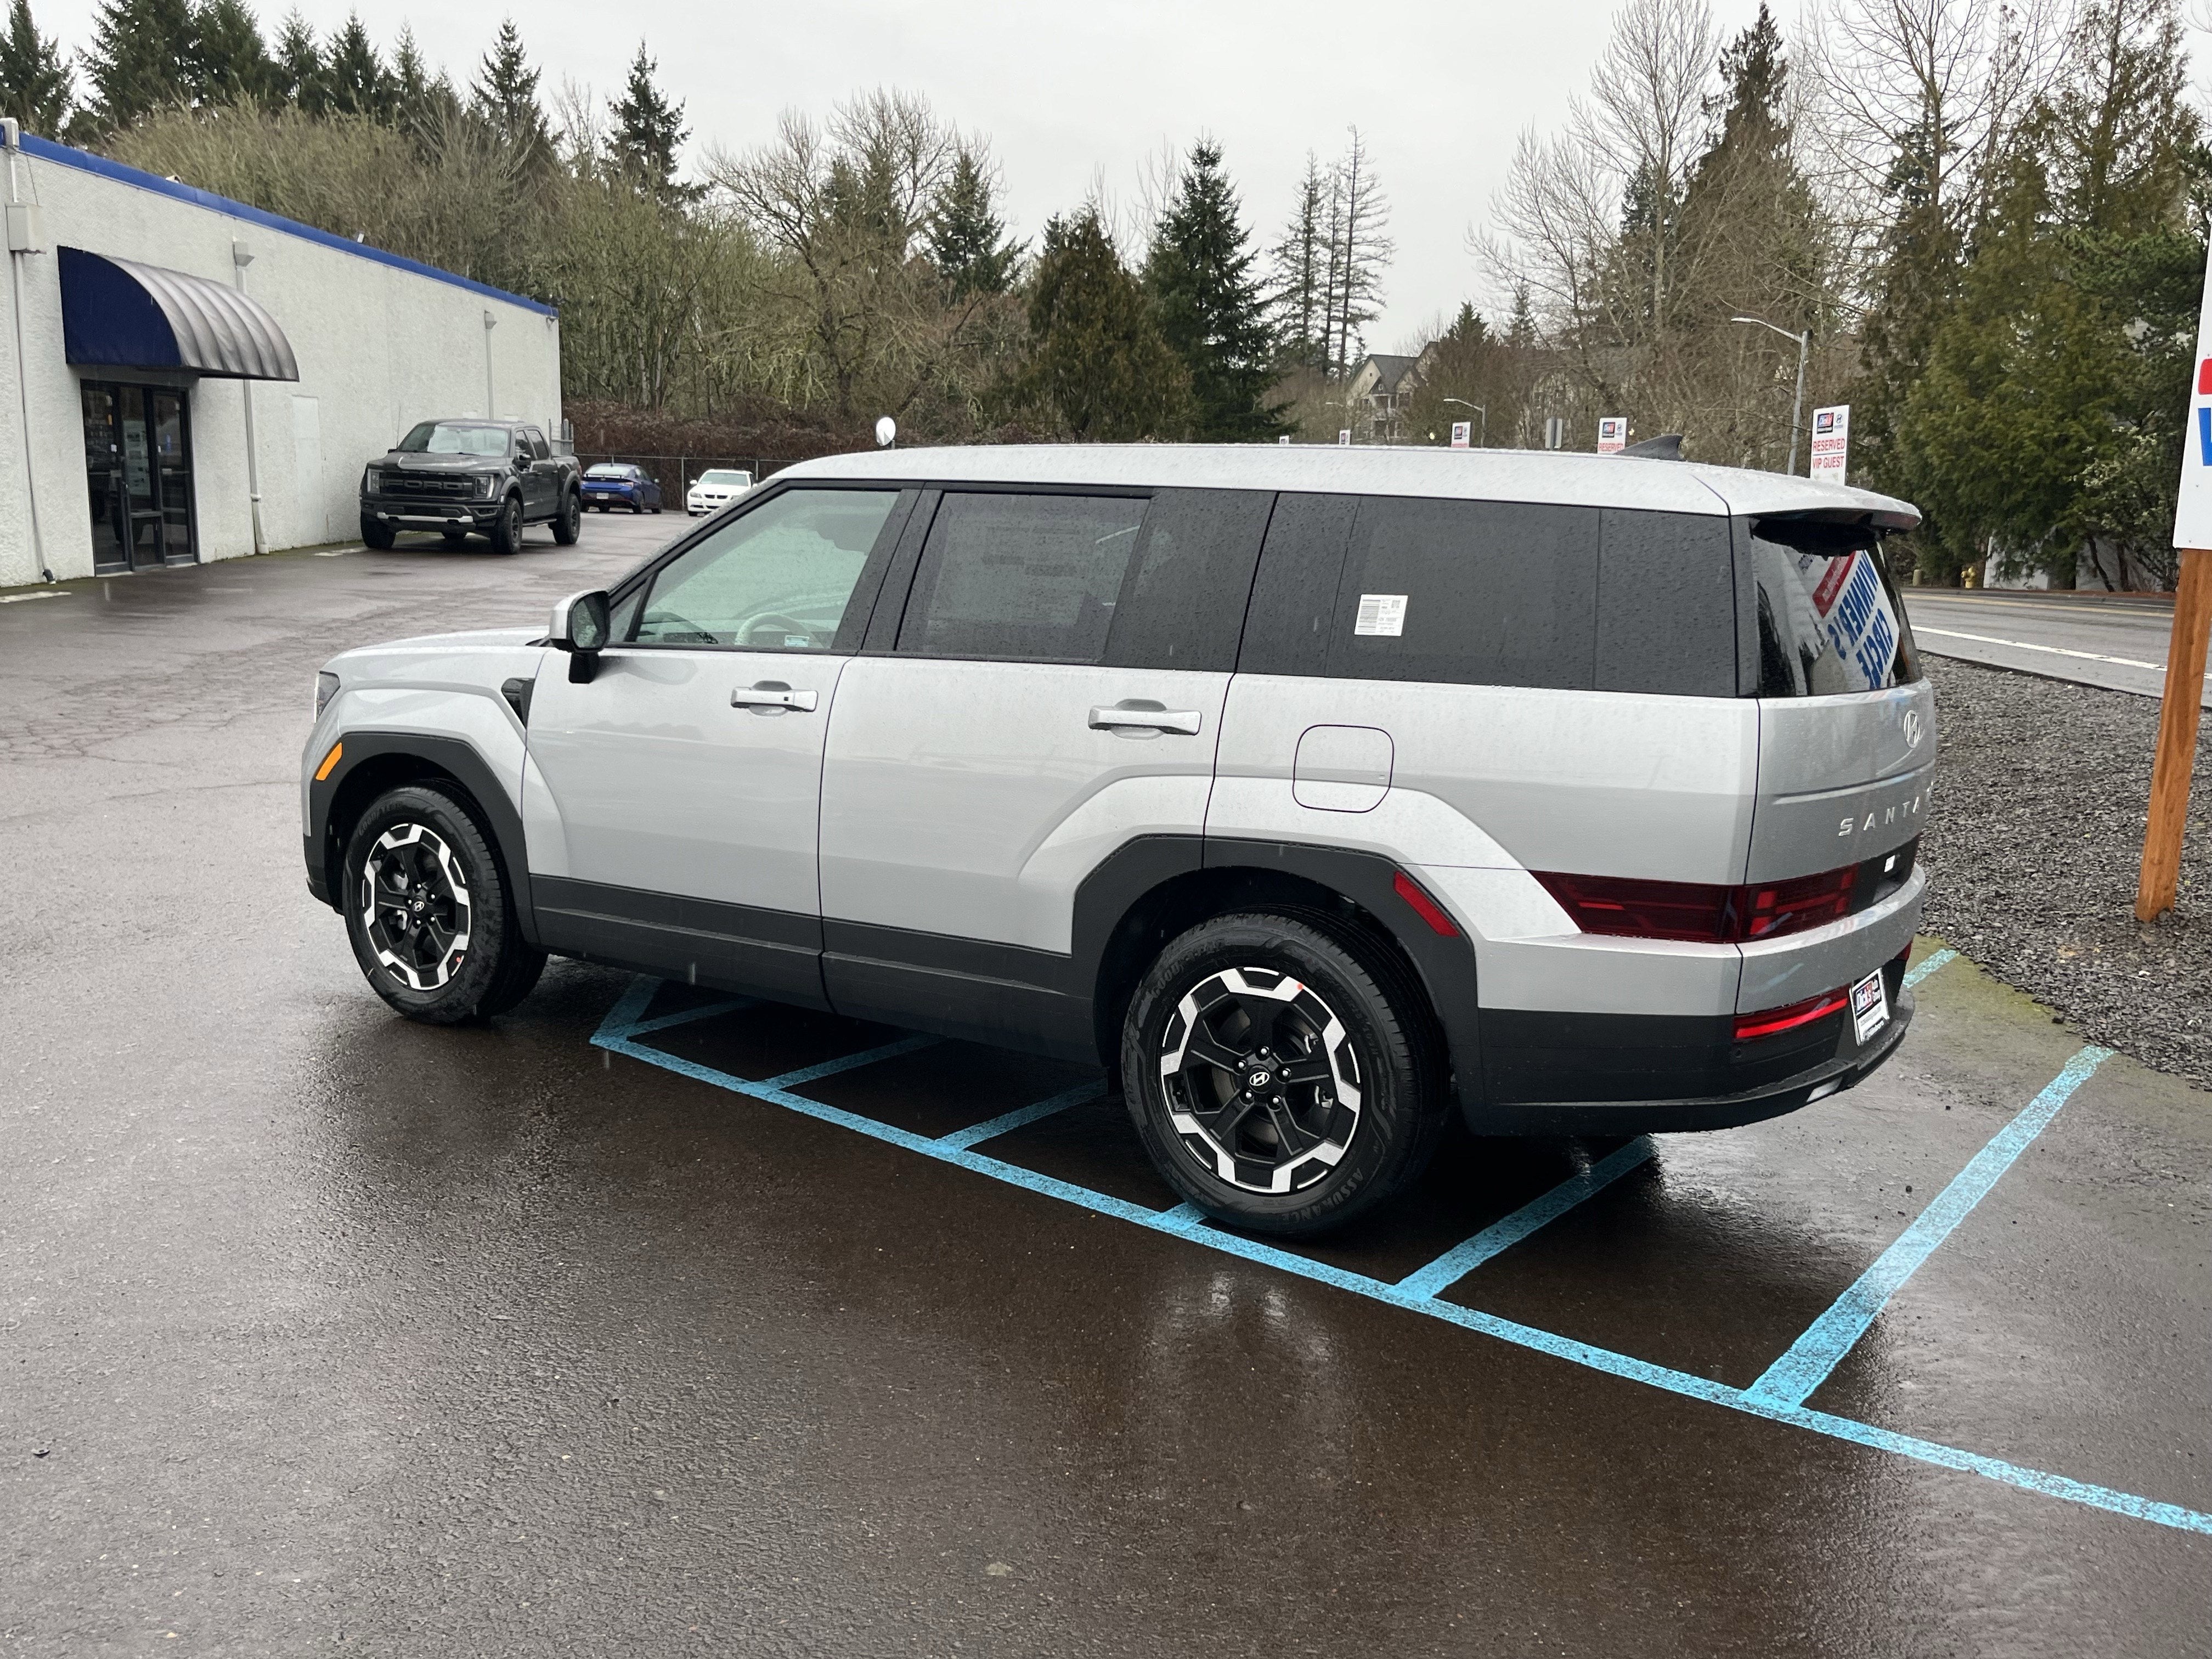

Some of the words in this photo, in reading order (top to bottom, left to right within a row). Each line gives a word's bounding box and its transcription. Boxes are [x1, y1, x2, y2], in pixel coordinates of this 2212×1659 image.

[1813, 438, 1845, 452] RESERVED
[1812, 458, 1821, 469] VIP
[1823, 456, 1844, 469] GUEST
[384, 478, 464, 490] FORD
[1282, 1167, 1364, 1224] ASSURANCE
